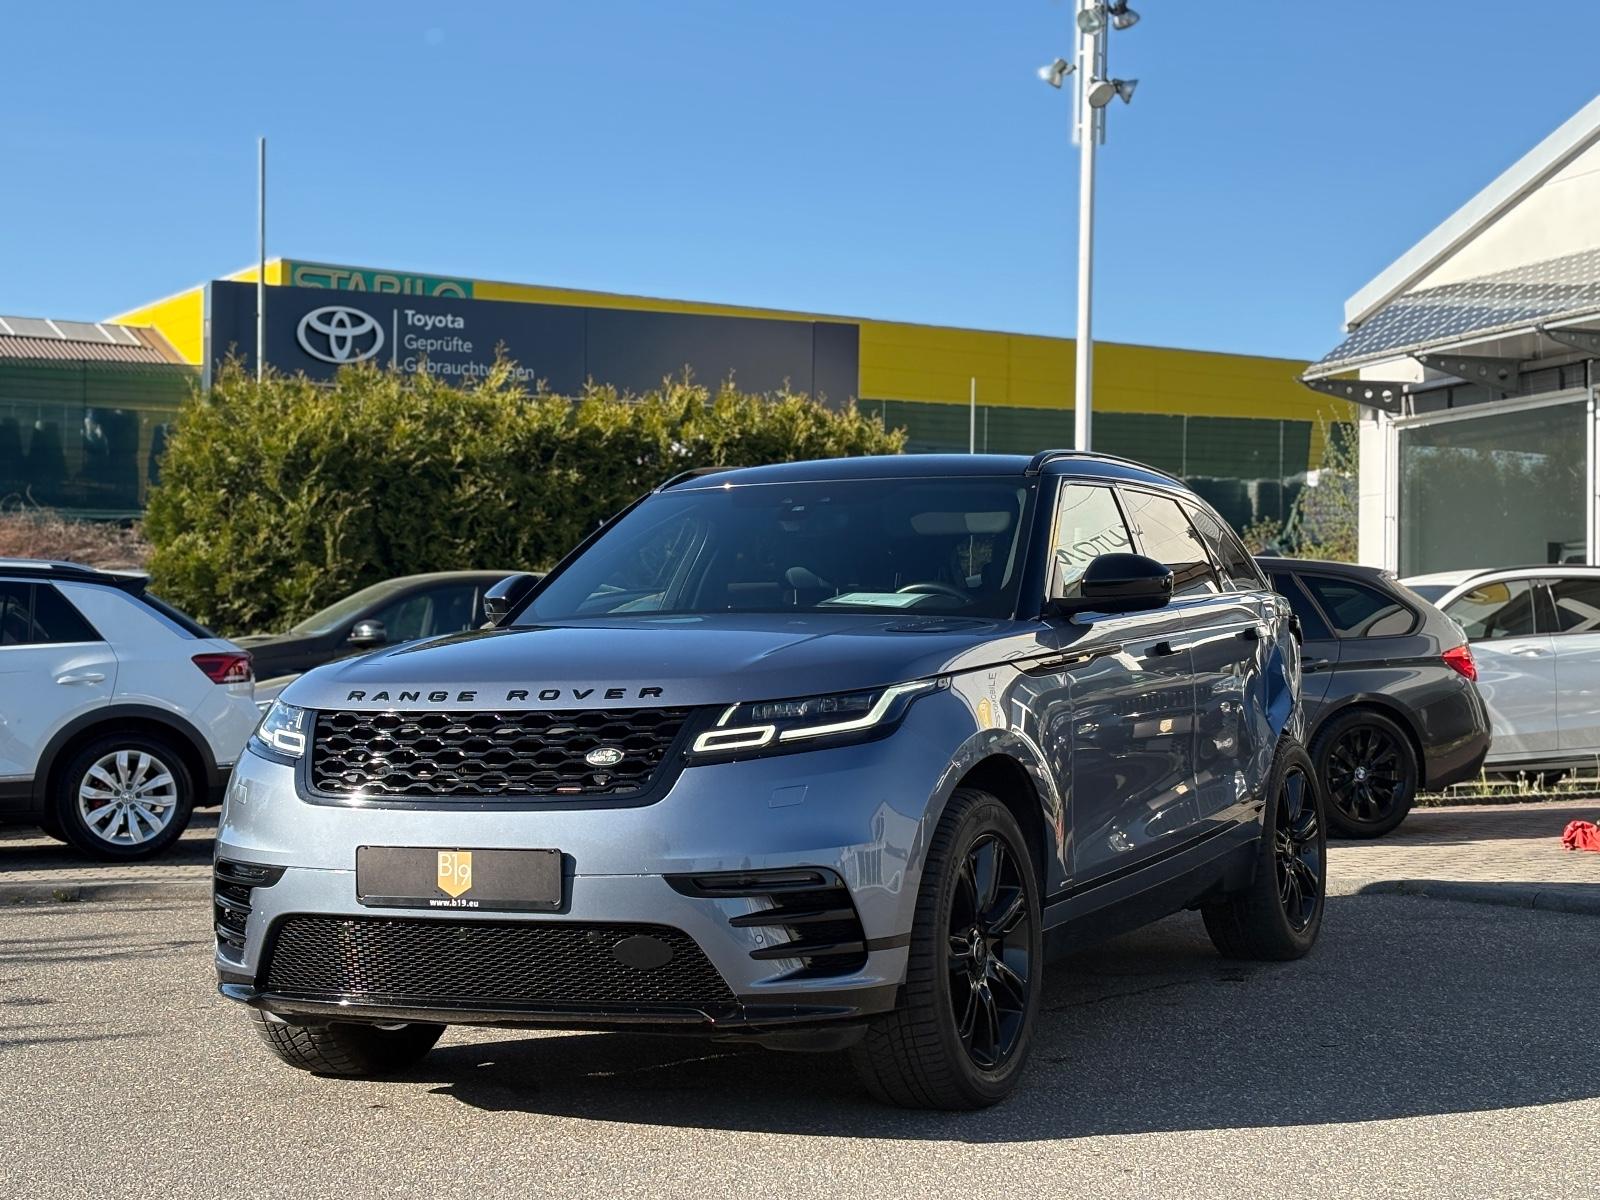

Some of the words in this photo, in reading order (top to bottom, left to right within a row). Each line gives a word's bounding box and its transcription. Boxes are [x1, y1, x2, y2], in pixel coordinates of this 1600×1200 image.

[404, 309, 465, 331] Toyota
[404, 334, 473, 353] Geprüfte
[404, 357, 535, 381] Gbrauchtwgen
[347, 690, 478, 702] RANGE
[506, 687, 664, 701] ROVER
[439, 853, 471, 886] B19
[429, 898, 479, 908] www.b19.eu
